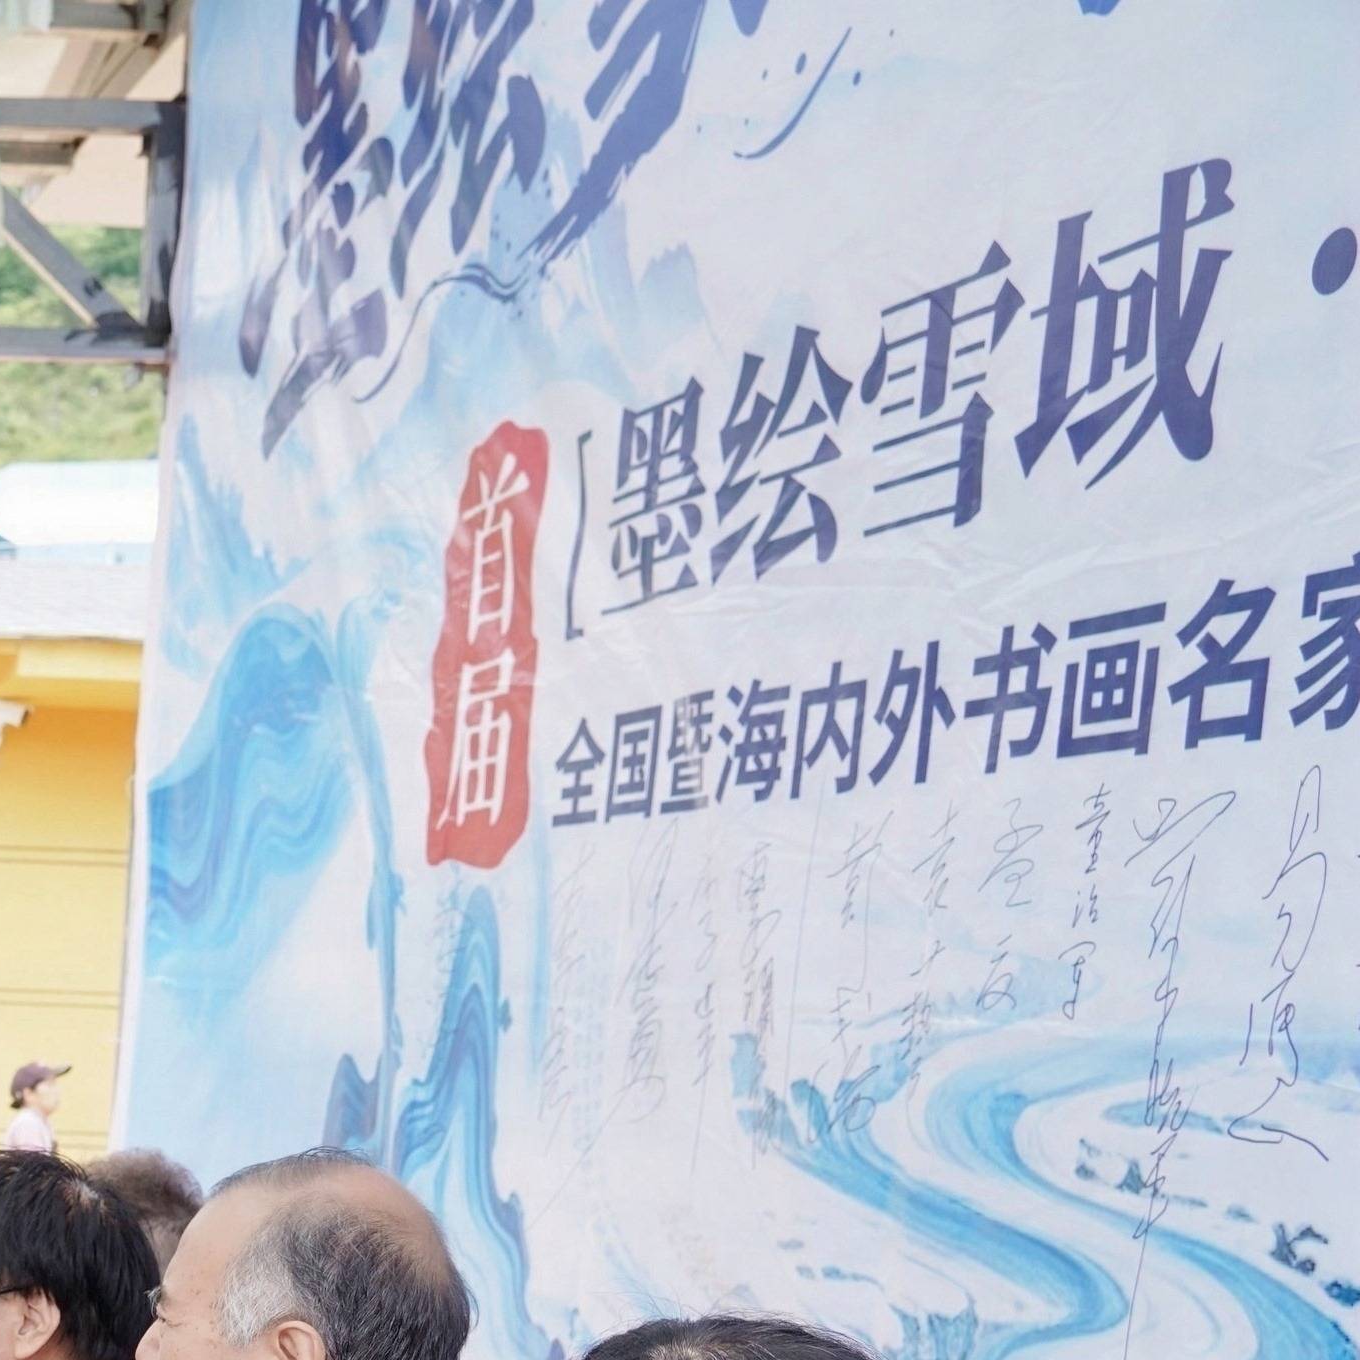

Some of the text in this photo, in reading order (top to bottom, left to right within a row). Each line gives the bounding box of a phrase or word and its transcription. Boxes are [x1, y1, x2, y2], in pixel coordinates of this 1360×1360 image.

[434, 453, 530, 831] 首届
[552, 552, 1360, 828] 全国暨海内外书画名家
